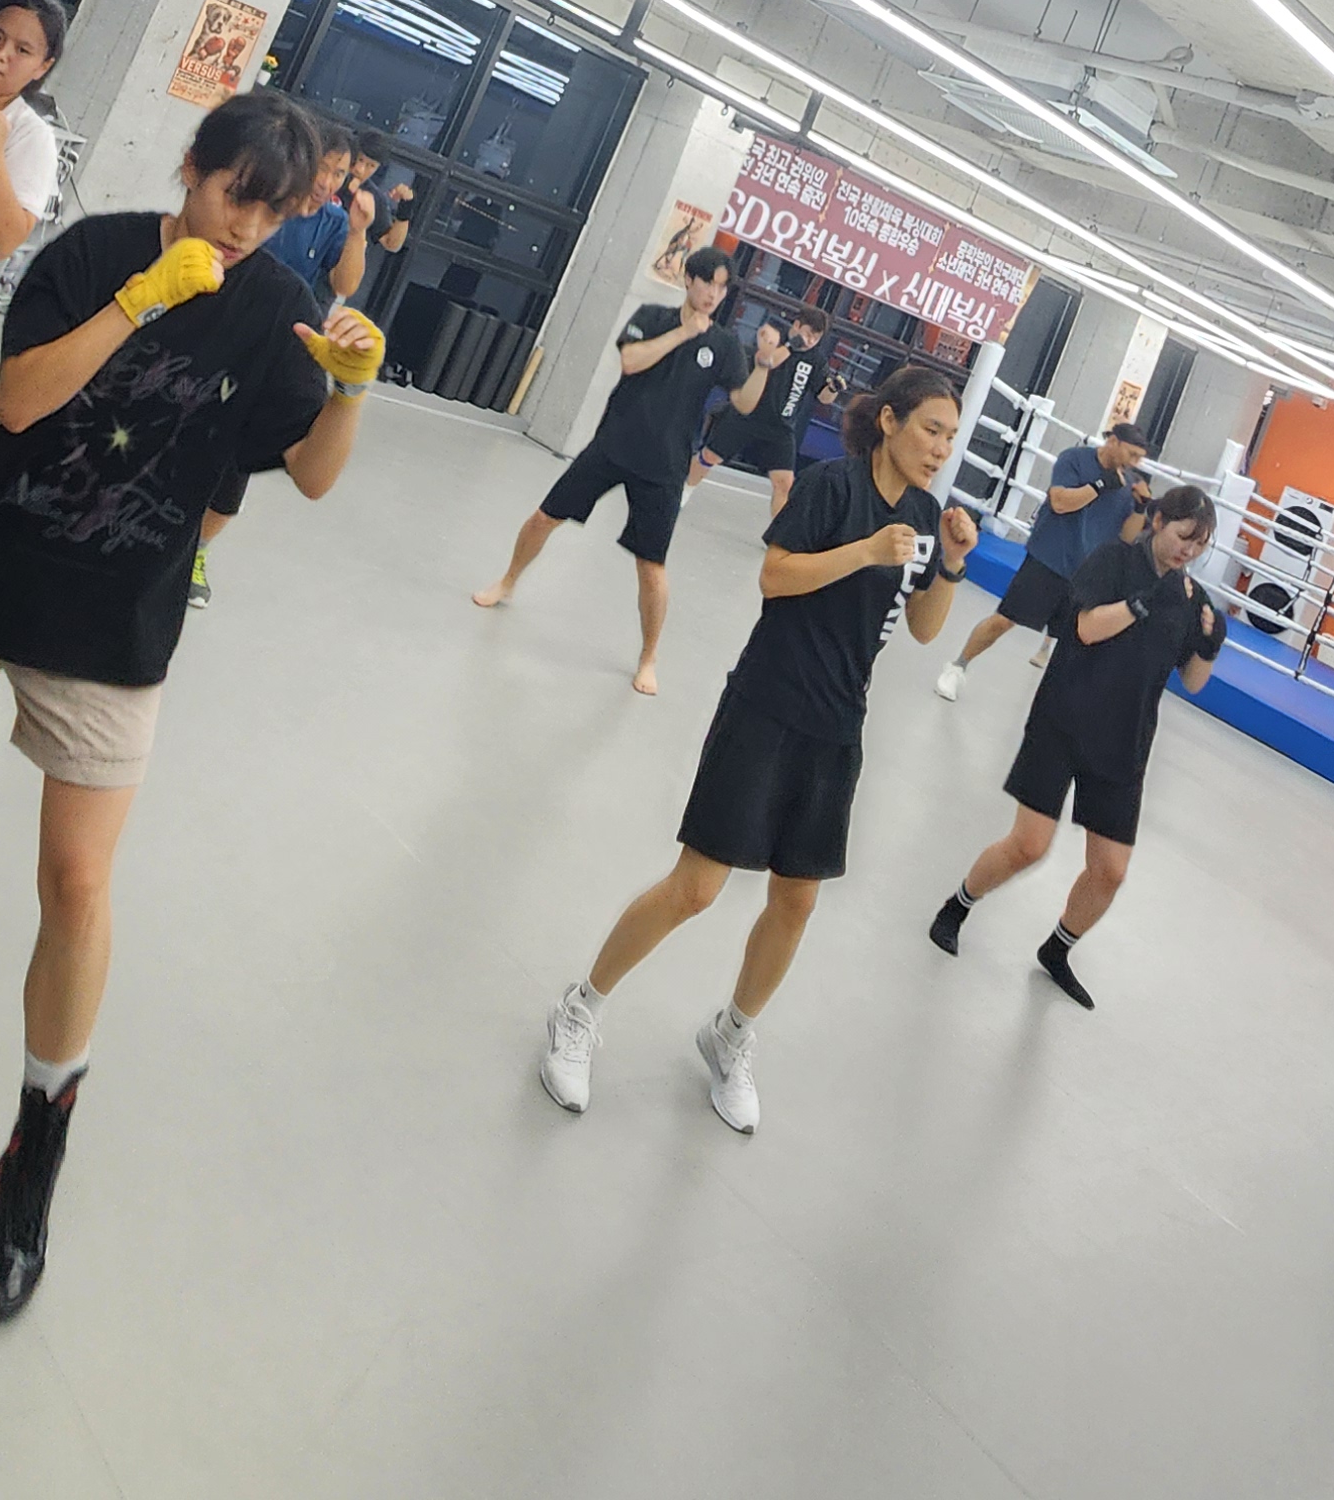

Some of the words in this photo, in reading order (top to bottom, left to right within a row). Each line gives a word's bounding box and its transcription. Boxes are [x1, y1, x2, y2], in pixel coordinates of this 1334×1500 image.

[181, 57, 223, 82] VERSUS
[750, 161, 778, 187] 3년
[774, 171, 802, 200] 연속
[799, 183, 827, 211] 출전
[763, 144, 792, 172] 최고
[789, 156, 829, 190] 권위의
[836, 180, 862, 206] 전국
[861, 192, 904, 228] 생활체육
[902, 212, 943, 247] 복싱대회
[844, 206, 880, 238] 10연속
[877, 222, 920, 257] 종합우승
[719, 187, 879, 289] SD오천복싱
[899, 271, 997, 341] 신대복싱
[973, 269, 993, 291] 3년
[990, 278, 1011, 300] 연속
[781, 360, 813, 418] BOXING
